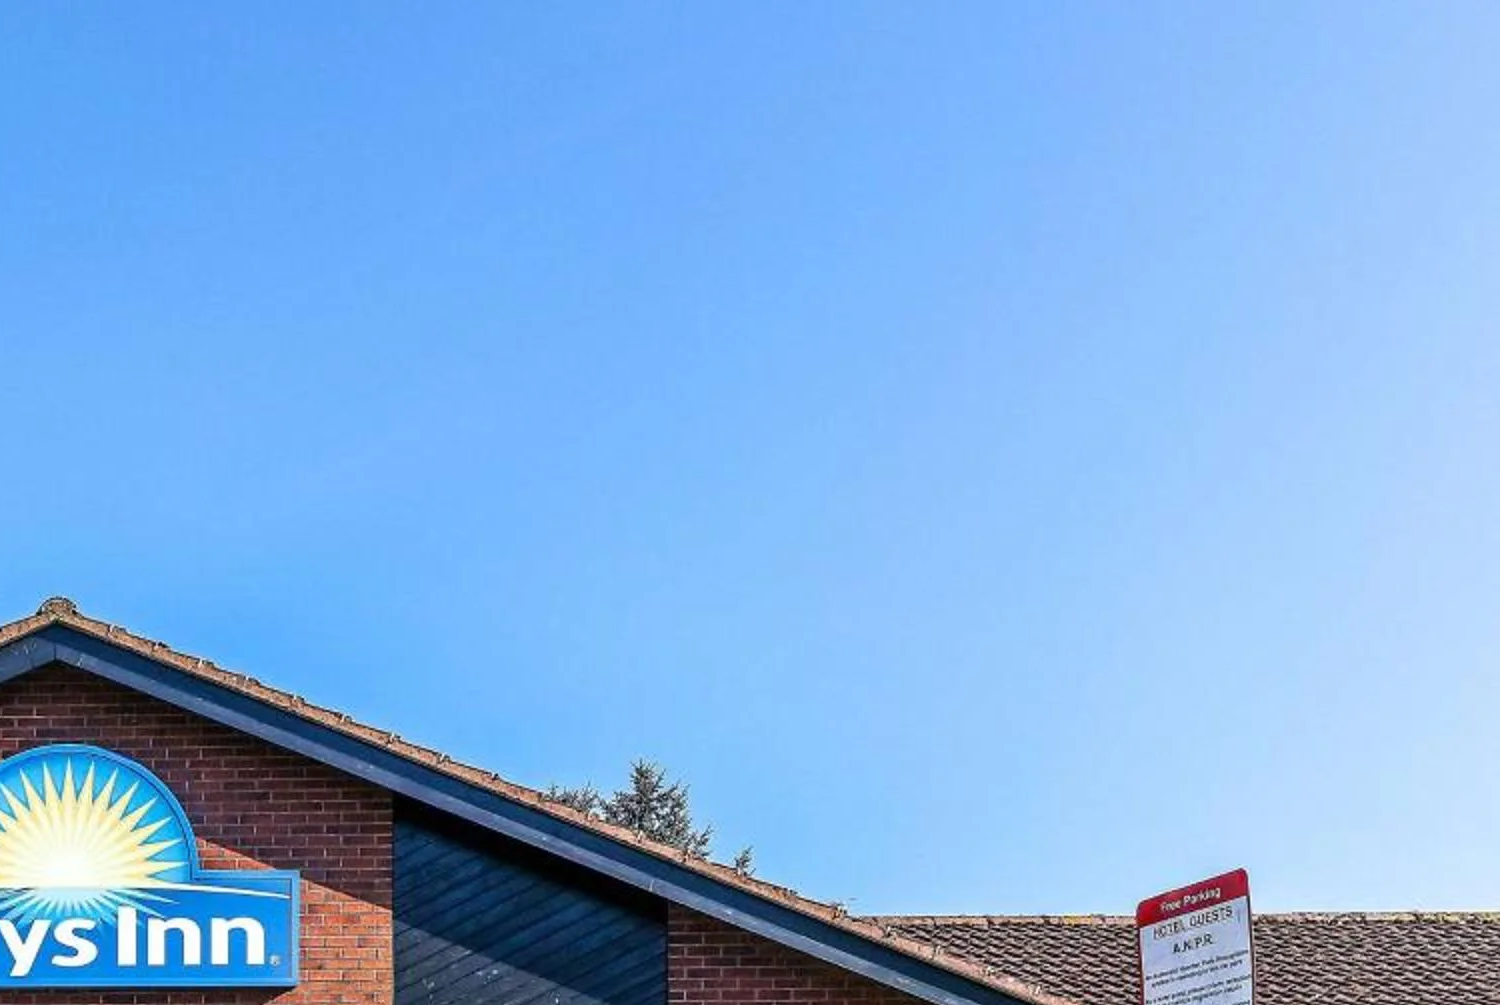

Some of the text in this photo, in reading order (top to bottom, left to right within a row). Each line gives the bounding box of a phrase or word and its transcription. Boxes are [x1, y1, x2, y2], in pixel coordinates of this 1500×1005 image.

[1161, 887, 1221, 912] Free Parking
[117, 905, 265, 966] Inn
[1153, 905, 1233, 940] HOTEL GUESTS
